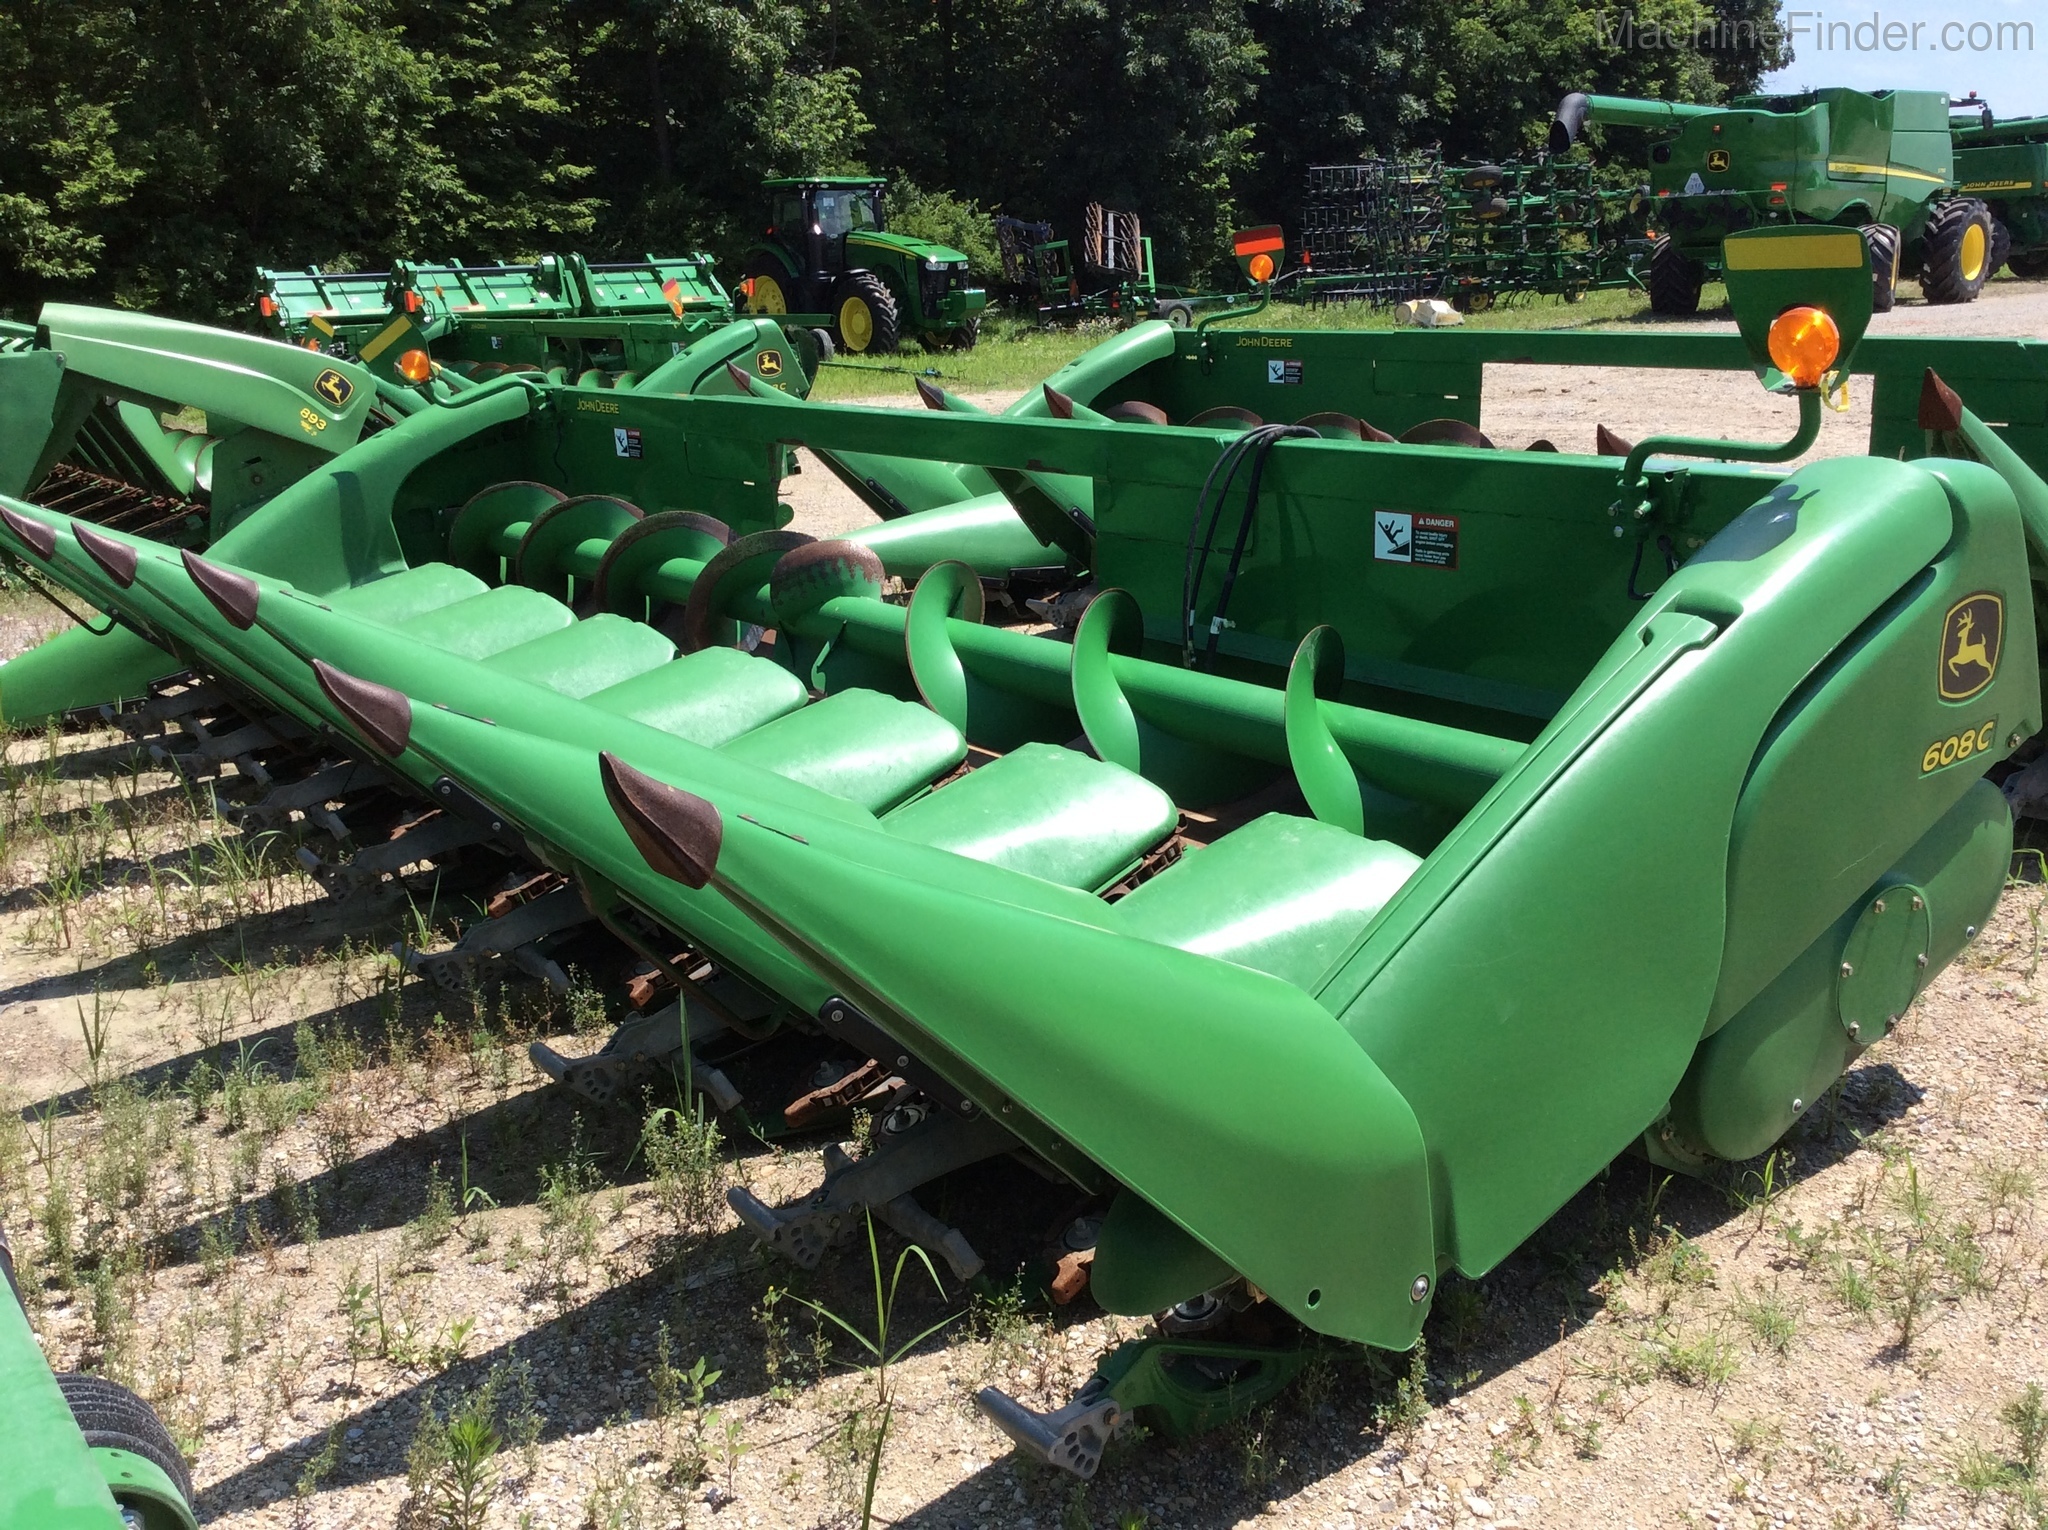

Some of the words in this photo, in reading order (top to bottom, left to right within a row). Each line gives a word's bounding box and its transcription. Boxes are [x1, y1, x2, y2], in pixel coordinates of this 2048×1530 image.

[1236, 336, 1260, 347] JOHN
[1261, 336, 1293, 347] DEERE
[577, 398, 596, 411] JOHN
[596, 399, 619, 414] DEERE
[300, 407, 327, 430] 893
[1425, 517, 1455, 528] DANGER
[1922, 720, 1995, 772] 608C
